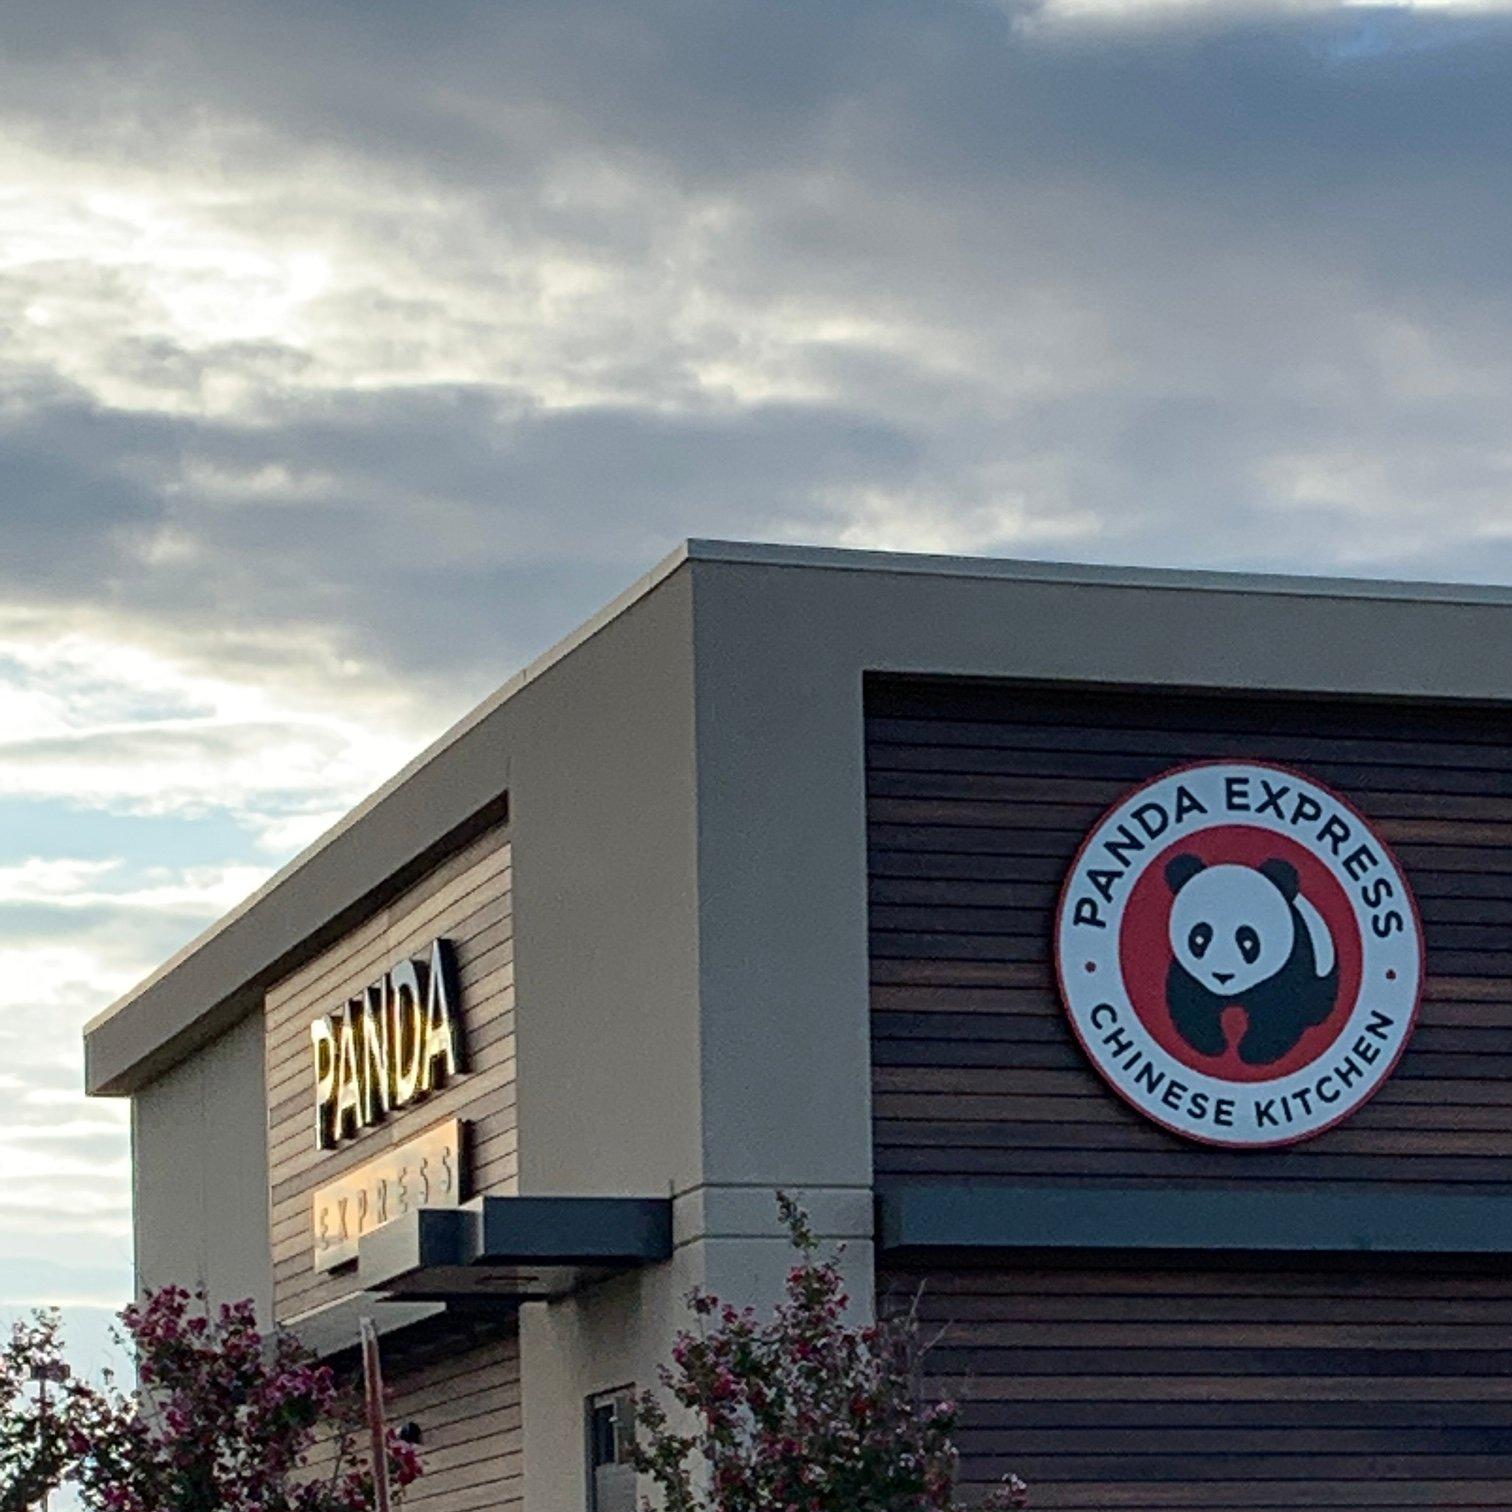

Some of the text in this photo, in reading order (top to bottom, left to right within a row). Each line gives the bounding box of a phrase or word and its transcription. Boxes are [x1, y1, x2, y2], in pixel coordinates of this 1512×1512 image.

[1073, 777, 1404, 938] PANDA EXPRESS
[310, 937, 466, 1151] PANDA
[1091, 1003, 1394, 1128] CHINESE KITCHEN
